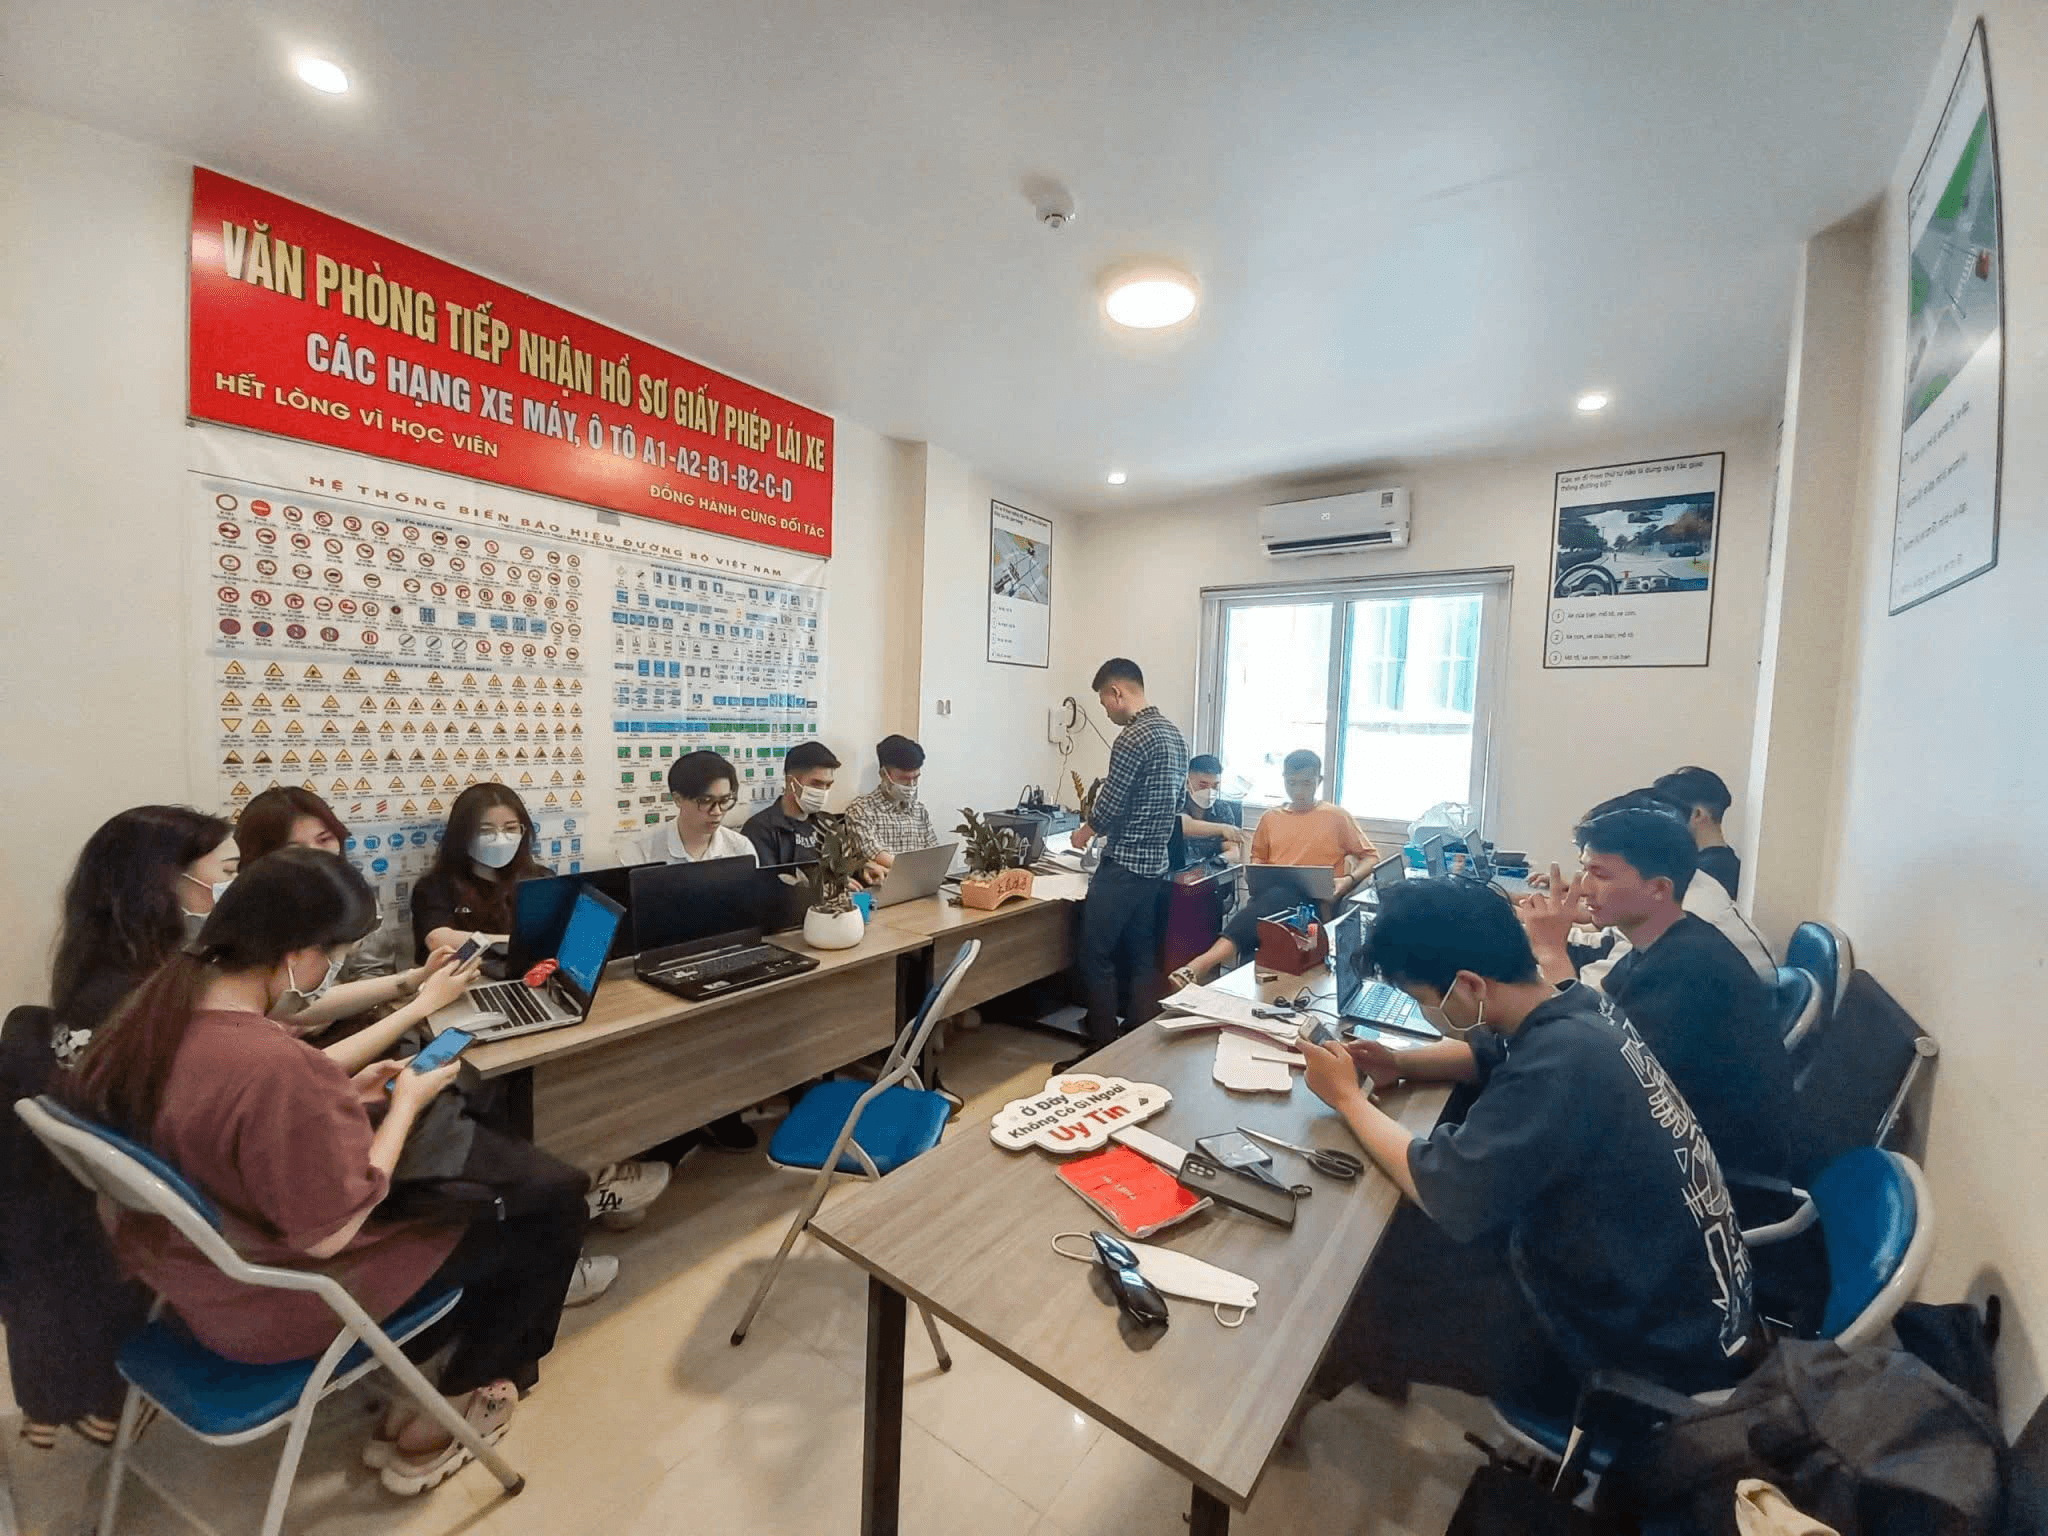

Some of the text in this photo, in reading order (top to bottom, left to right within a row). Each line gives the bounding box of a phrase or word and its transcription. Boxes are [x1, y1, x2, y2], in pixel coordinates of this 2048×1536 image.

[222, 219, 825, 472] VĂN PHÒNG TIẾP NHẬN HỒ SƠ GIẤY PHÉP LÁI XE
[215, 372, 498, 458] HẾT LÒNG VÌ HỌC VIÊN
[306, 333, 793, 503] CÁC HẠNG XE MÁY, Ô TÔ A1-A2-B1-B2-C-D
[650, 483, 825, 538] ĐỒNG HÀNH CÙNG ĐỐI TÁC
[716, 558, 747, 570] VIỆT
[754, 565, 782, 577] NAM
[1008, 1115, 1059, 1139] Không
[1054, 1106, 1076, 1117] Có
[1087, 1083, 1126, 1104] Ngoài
[1020, 1094, 1070, 1117] Ở Đây
[1047, 1121, 1091, 1141] Uy
